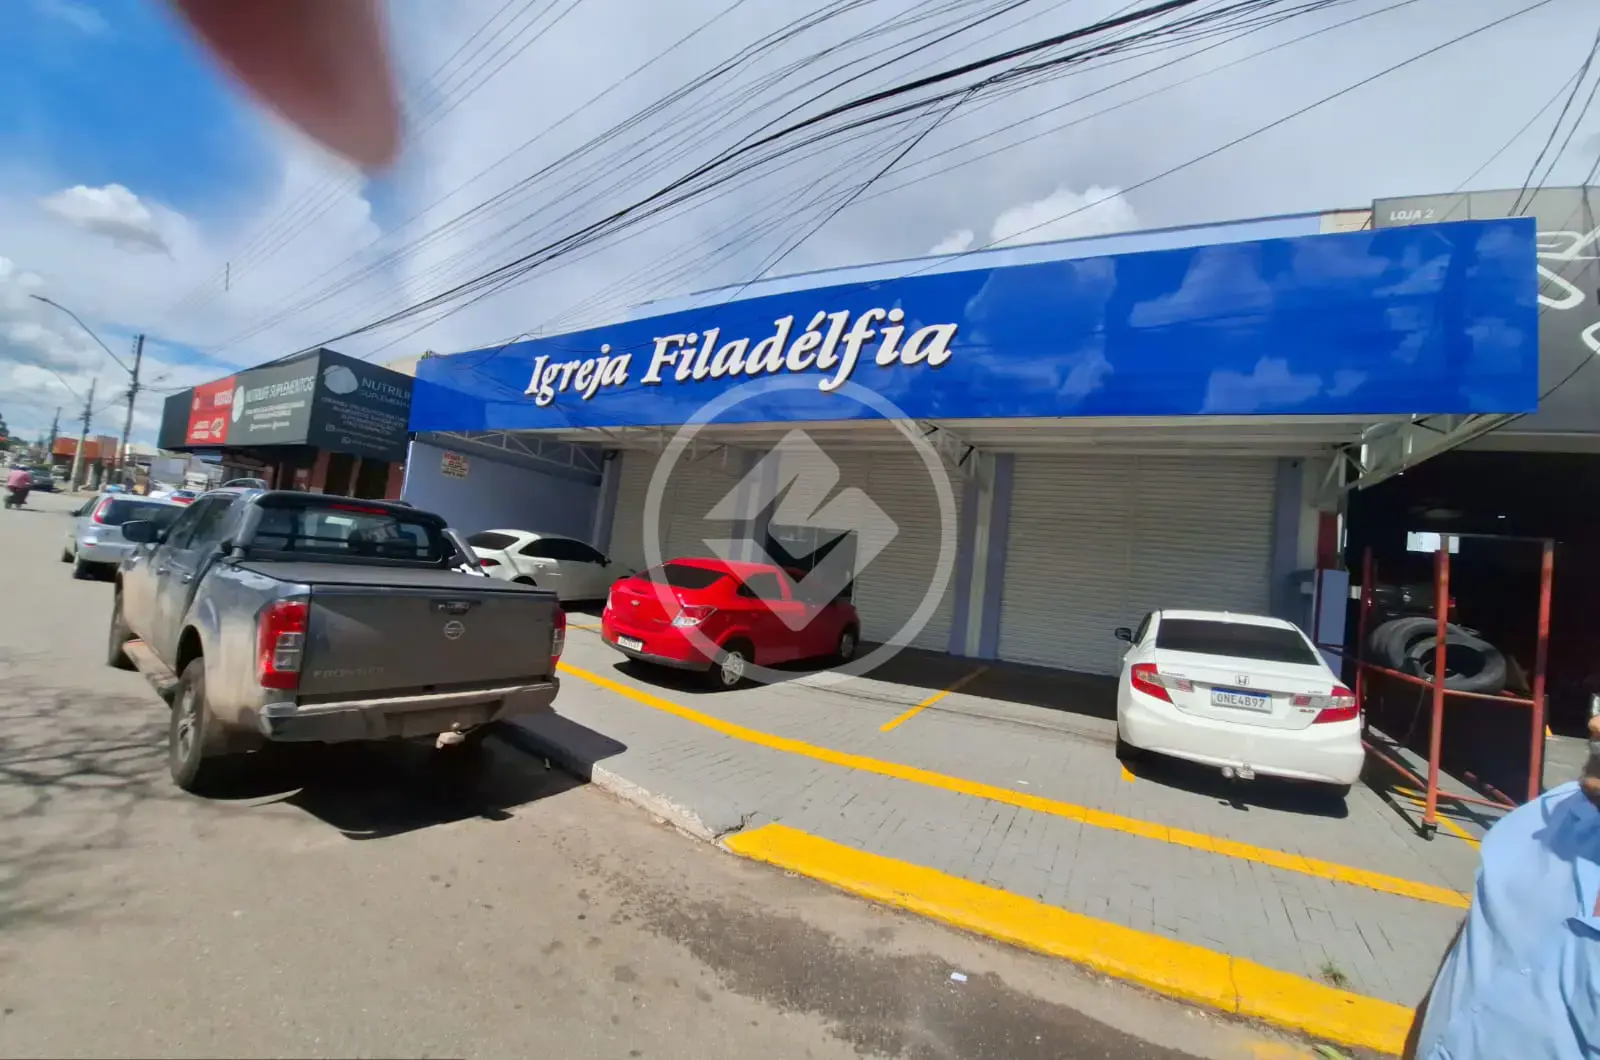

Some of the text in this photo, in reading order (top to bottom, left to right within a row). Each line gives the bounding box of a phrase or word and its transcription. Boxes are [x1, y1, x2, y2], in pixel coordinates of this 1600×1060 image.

[1390, 208, 1435, 221] LOJA 2
[524, 308, 959, 407] Igreja Filadélfia
